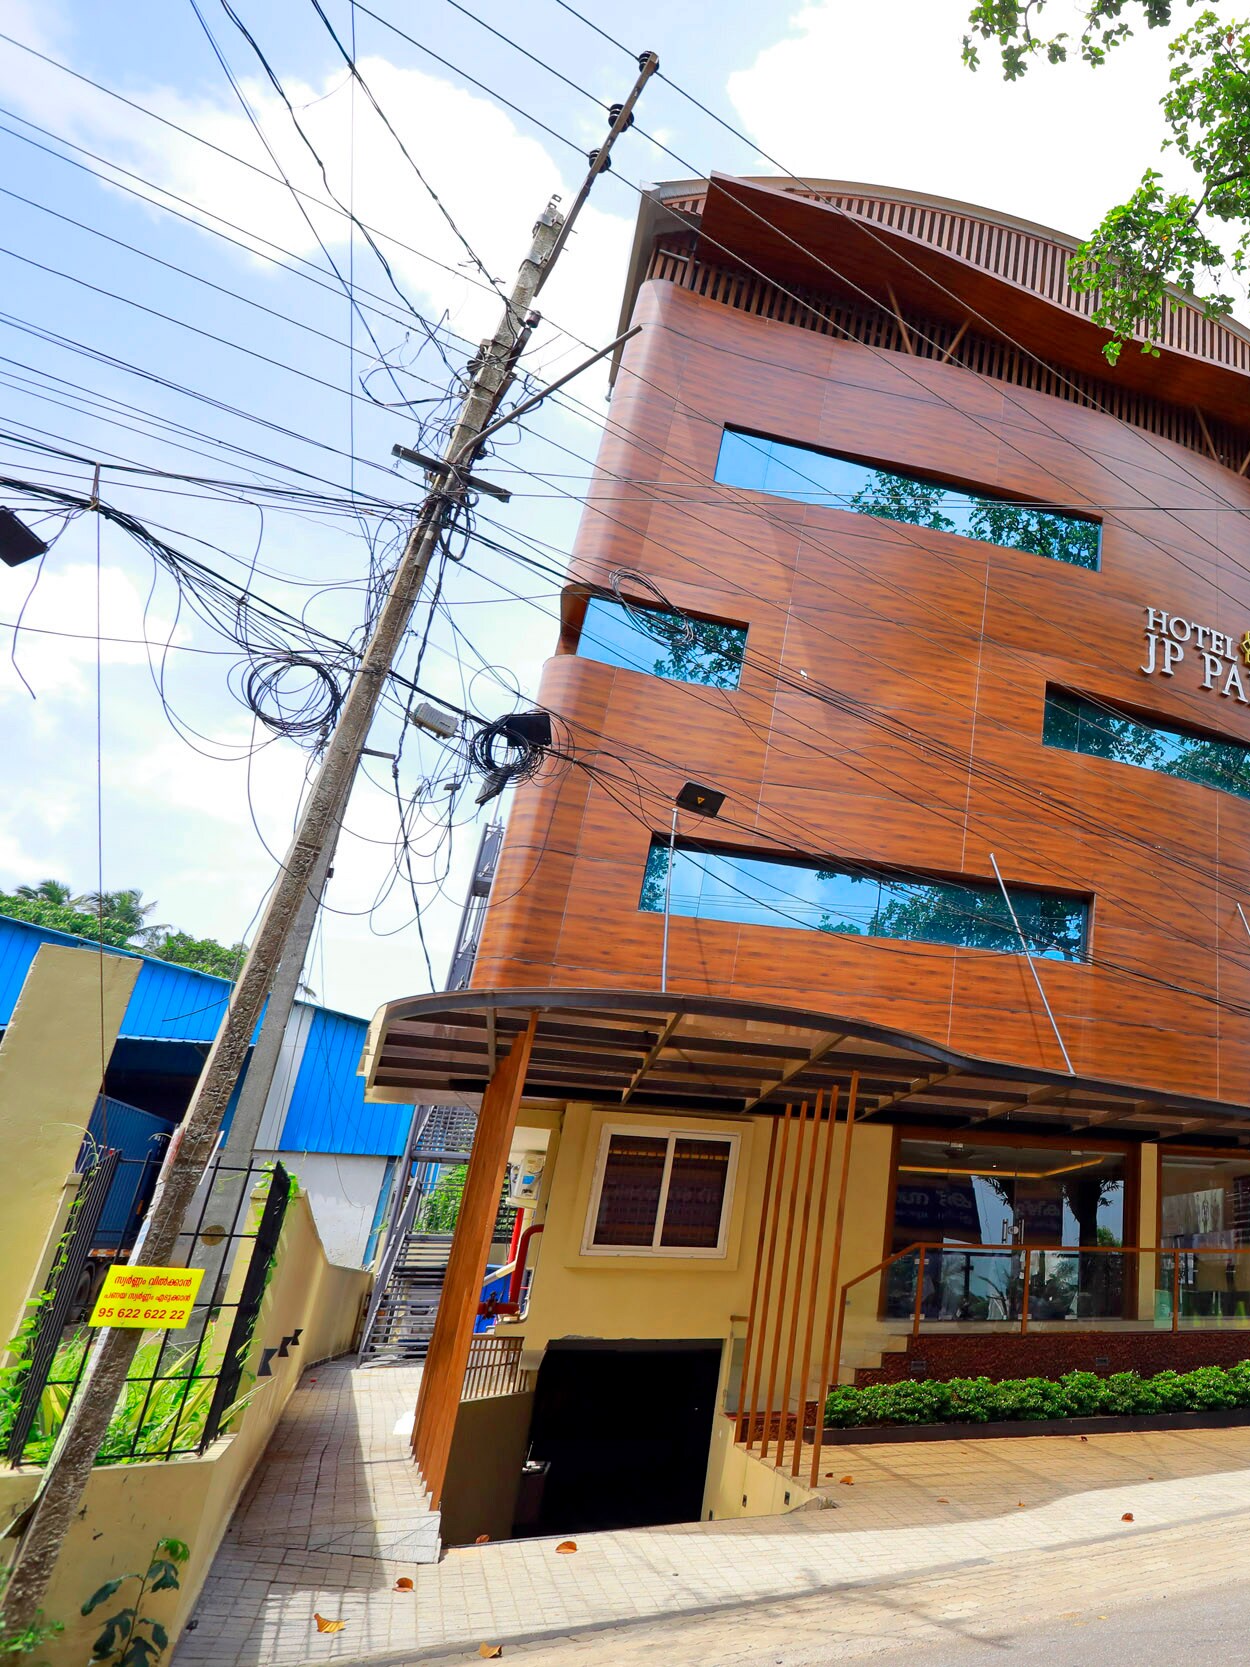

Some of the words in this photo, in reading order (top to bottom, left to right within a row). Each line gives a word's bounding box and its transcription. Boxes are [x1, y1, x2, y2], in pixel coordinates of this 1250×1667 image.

[1140, 632, 1185, 676] JP
[1145, 606, 1239, 662] HOTEL
[98, 1307, 114, 1318] 95
[117, 1308, 141, 1318] 622
[143, 1309, 167, 1319] 622
[169, 1310, 185, 1320] 22
